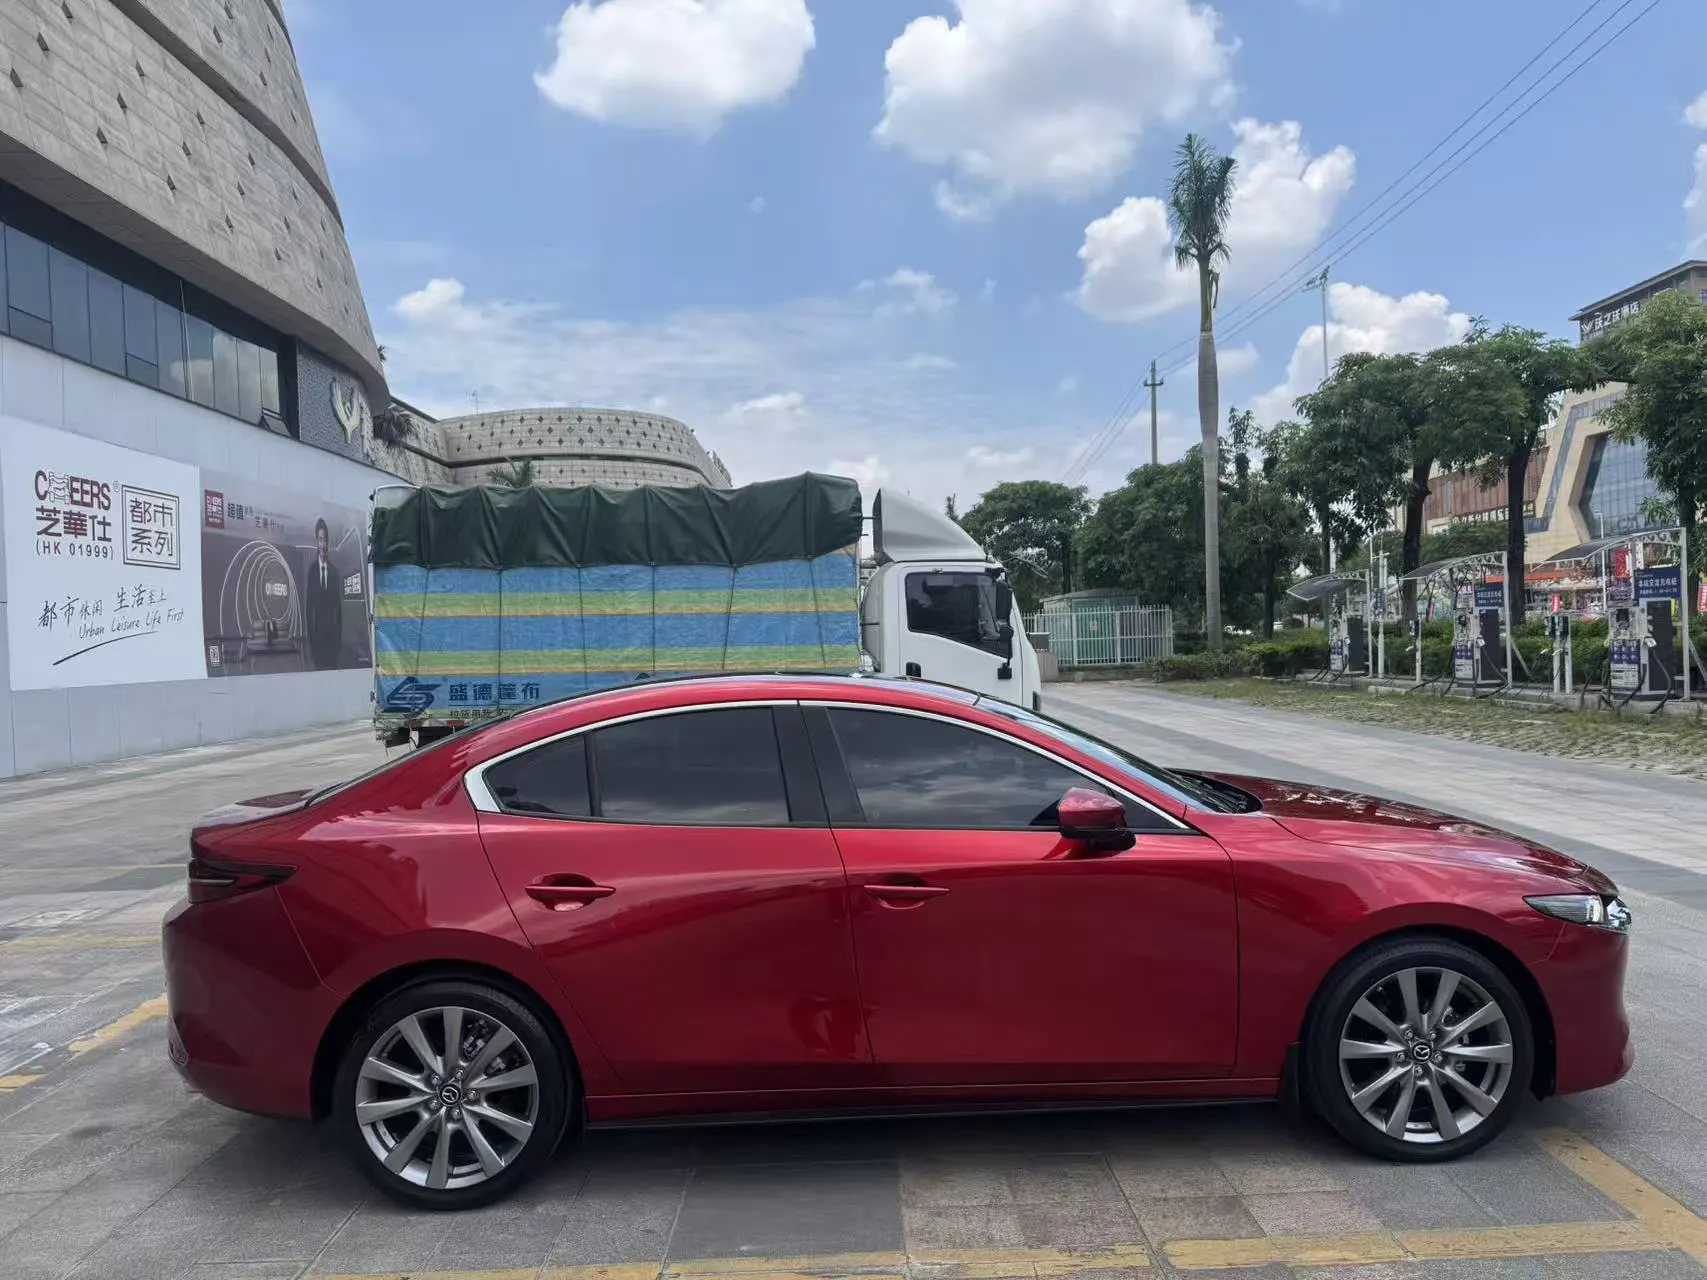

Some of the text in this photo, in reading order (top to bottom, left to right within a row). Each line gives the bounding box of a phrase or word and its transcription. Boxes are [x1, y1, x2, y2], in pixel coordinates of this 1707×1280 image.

[34, 470, 111, 511] CHEERS
[36, 505, 112, 543] 芝華仕
[130, 497, 173, 527] 都市
[36, 539, 114, 561] (HK 01999)
[131, 527, 173, 557] 系列
[79, 607, 184, 639] Urban Leisure Life First
